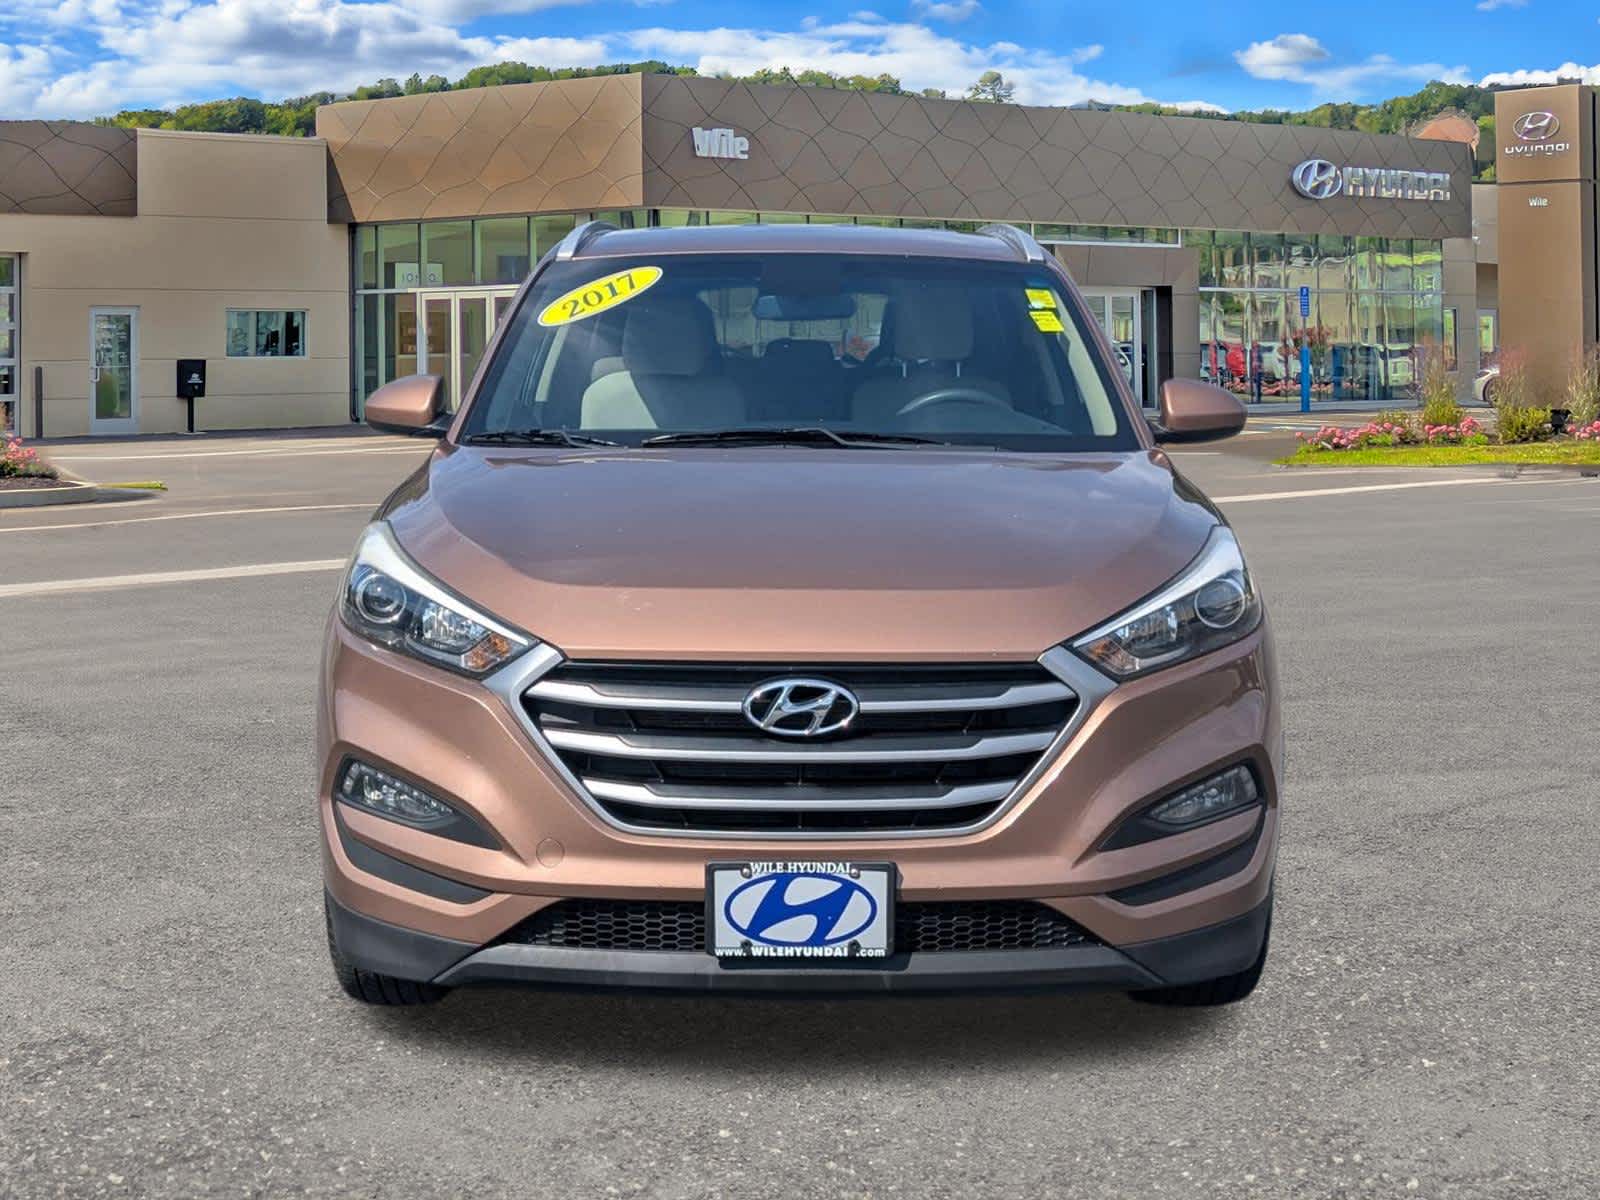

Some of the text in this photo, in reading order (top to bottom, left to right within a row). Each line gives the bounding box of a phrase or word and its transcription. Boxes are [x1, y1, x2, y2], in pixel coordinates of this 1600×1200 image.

[692, 127, 749, 159] Wile
[1343, 167, 1450, 200] HYUNDAI
[562, 273, 636, 318] 2017
[750, 862, 851, 874] WILE HYUNDAI
